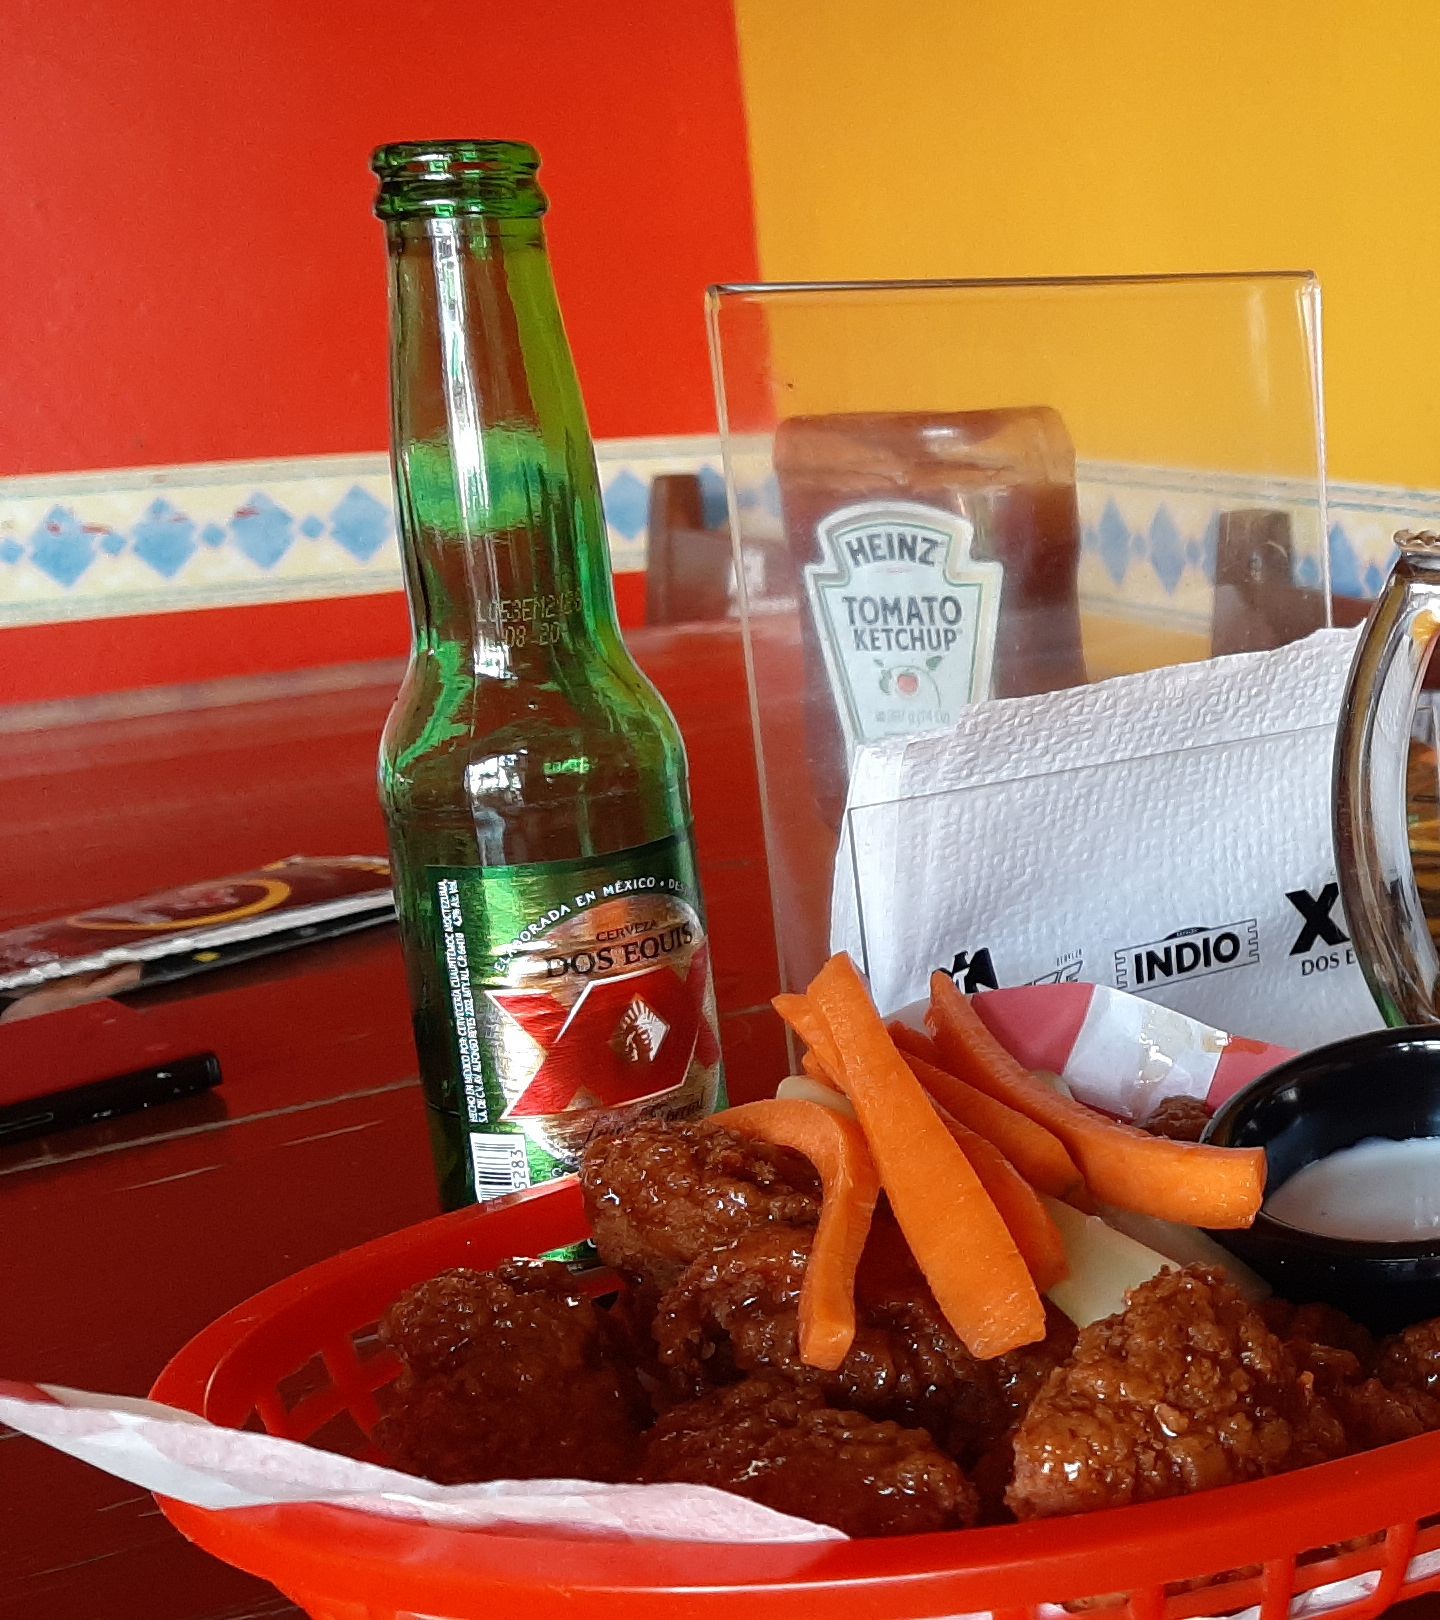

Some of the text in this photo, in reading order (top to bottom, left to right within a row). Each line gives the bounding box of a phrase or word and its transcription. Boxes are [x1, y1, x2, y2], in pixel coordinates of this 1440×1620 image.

[845, 533, 940, 568] HEINZ
[842, 595, 963, 627] TOMATO
[853, 627, 958, 651] KETCHUP
[574, 890, 597, 908] EN
[603, 876, 656, 897] MÉXICO
[596, 919, 657, 942] CERVEZA
[546, 921, 693, 977] DOS EQUIS
[1134, 932, 1240, 984] INDIO
[1301, 952, 1340, 976] DOS
